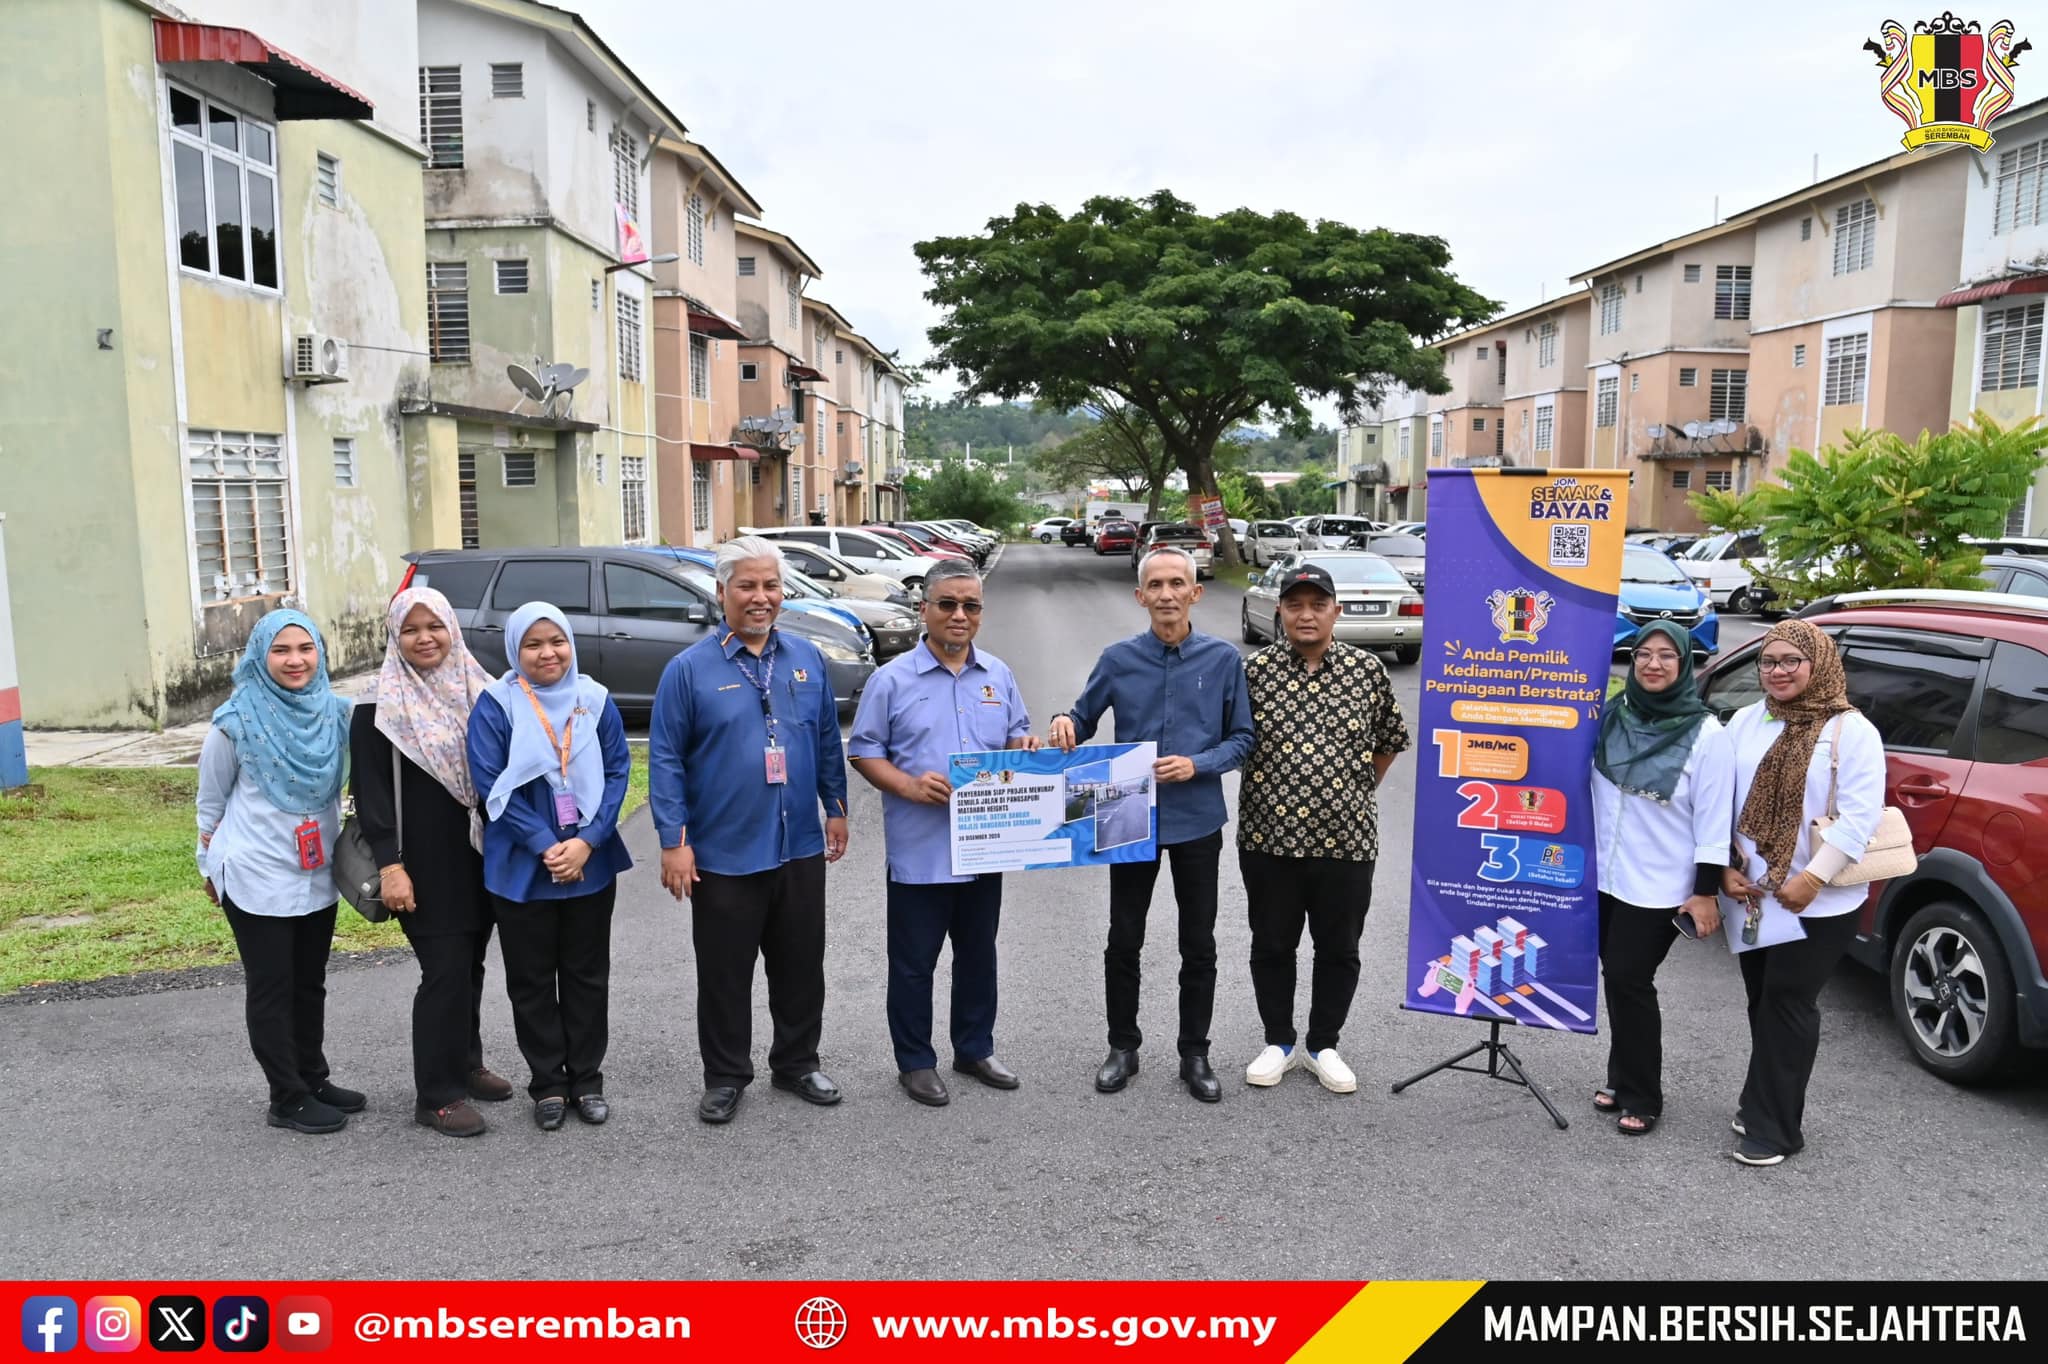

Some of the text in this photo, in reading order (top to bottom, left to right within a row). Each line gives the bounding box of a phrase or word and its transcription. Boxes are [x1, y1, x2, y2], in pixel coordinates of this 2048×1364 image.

[1553, 478, 1576, 486] JOM
[1530, 501, 1609, 520] BAYAR
[1462, 647, 1569, 665] Anda Pemilik
[1443, 663, 1588, 683] Kediaman/Premis
[1425, 679, 1601, 701] Perniagaan Berstrata?
[1461, 712, 1484, 721] Anda
[1485, 714, 1519, 724] Dengan
[1467, 739, 1517, 752] JMB/MC
[1433, 728, 1461, 778] 1
[957, 790, 992, 798] PENYERAHAN
[993, 788, 1005, 796] SIAP
[1007, 787, 1027, 795] PROJEK
[957, 798, 979, 806] SEMULA
[981, 797, 998, 805] JALAN
[1456, 780, 1498, 830] 2
[958, 806, 985, 814] MATAHARI
[1013, 818, 1041, 827] SEREMBAN
[1477, 833, 1520, 882] 3
[1463, 882, 1475, 890] dan
[1477, 885, 1495, 893] bayar
[1496, 887, 1515, 895] cukai
[1467, 899, 1495, 907] tindakan
[1472, 893, 1517, 902] mengelakkan
[1519, 896, 1539, 904] denda
[1540, 898, 1557, 906] lewat
[1558, 901, 1571, 909] dan
